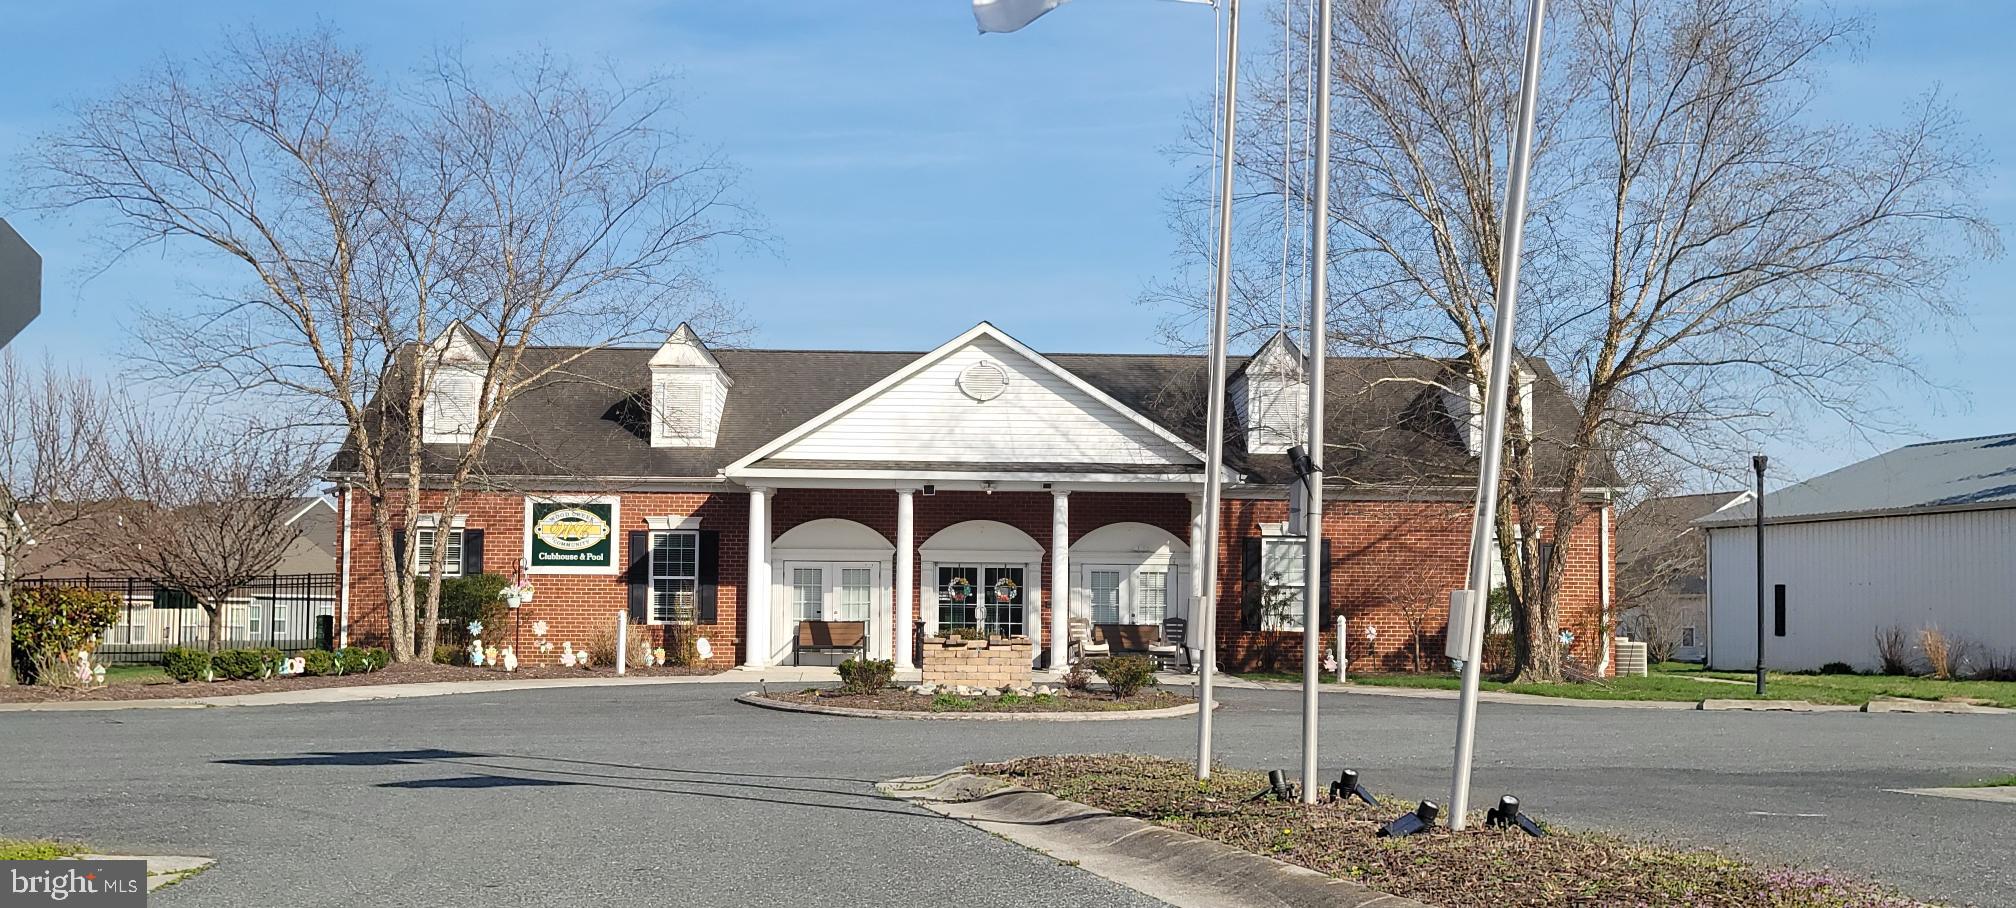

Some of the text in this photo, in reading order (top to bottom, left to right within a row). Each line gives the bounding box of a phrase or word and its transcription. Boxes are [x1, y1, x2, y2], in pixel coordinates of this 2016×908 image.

[549, 511, 595, 523] WOOD CREEK
[553, 538, 590, 547] COMMUNITY
[538, 552, 604, 561] Clubhouse & Pool
